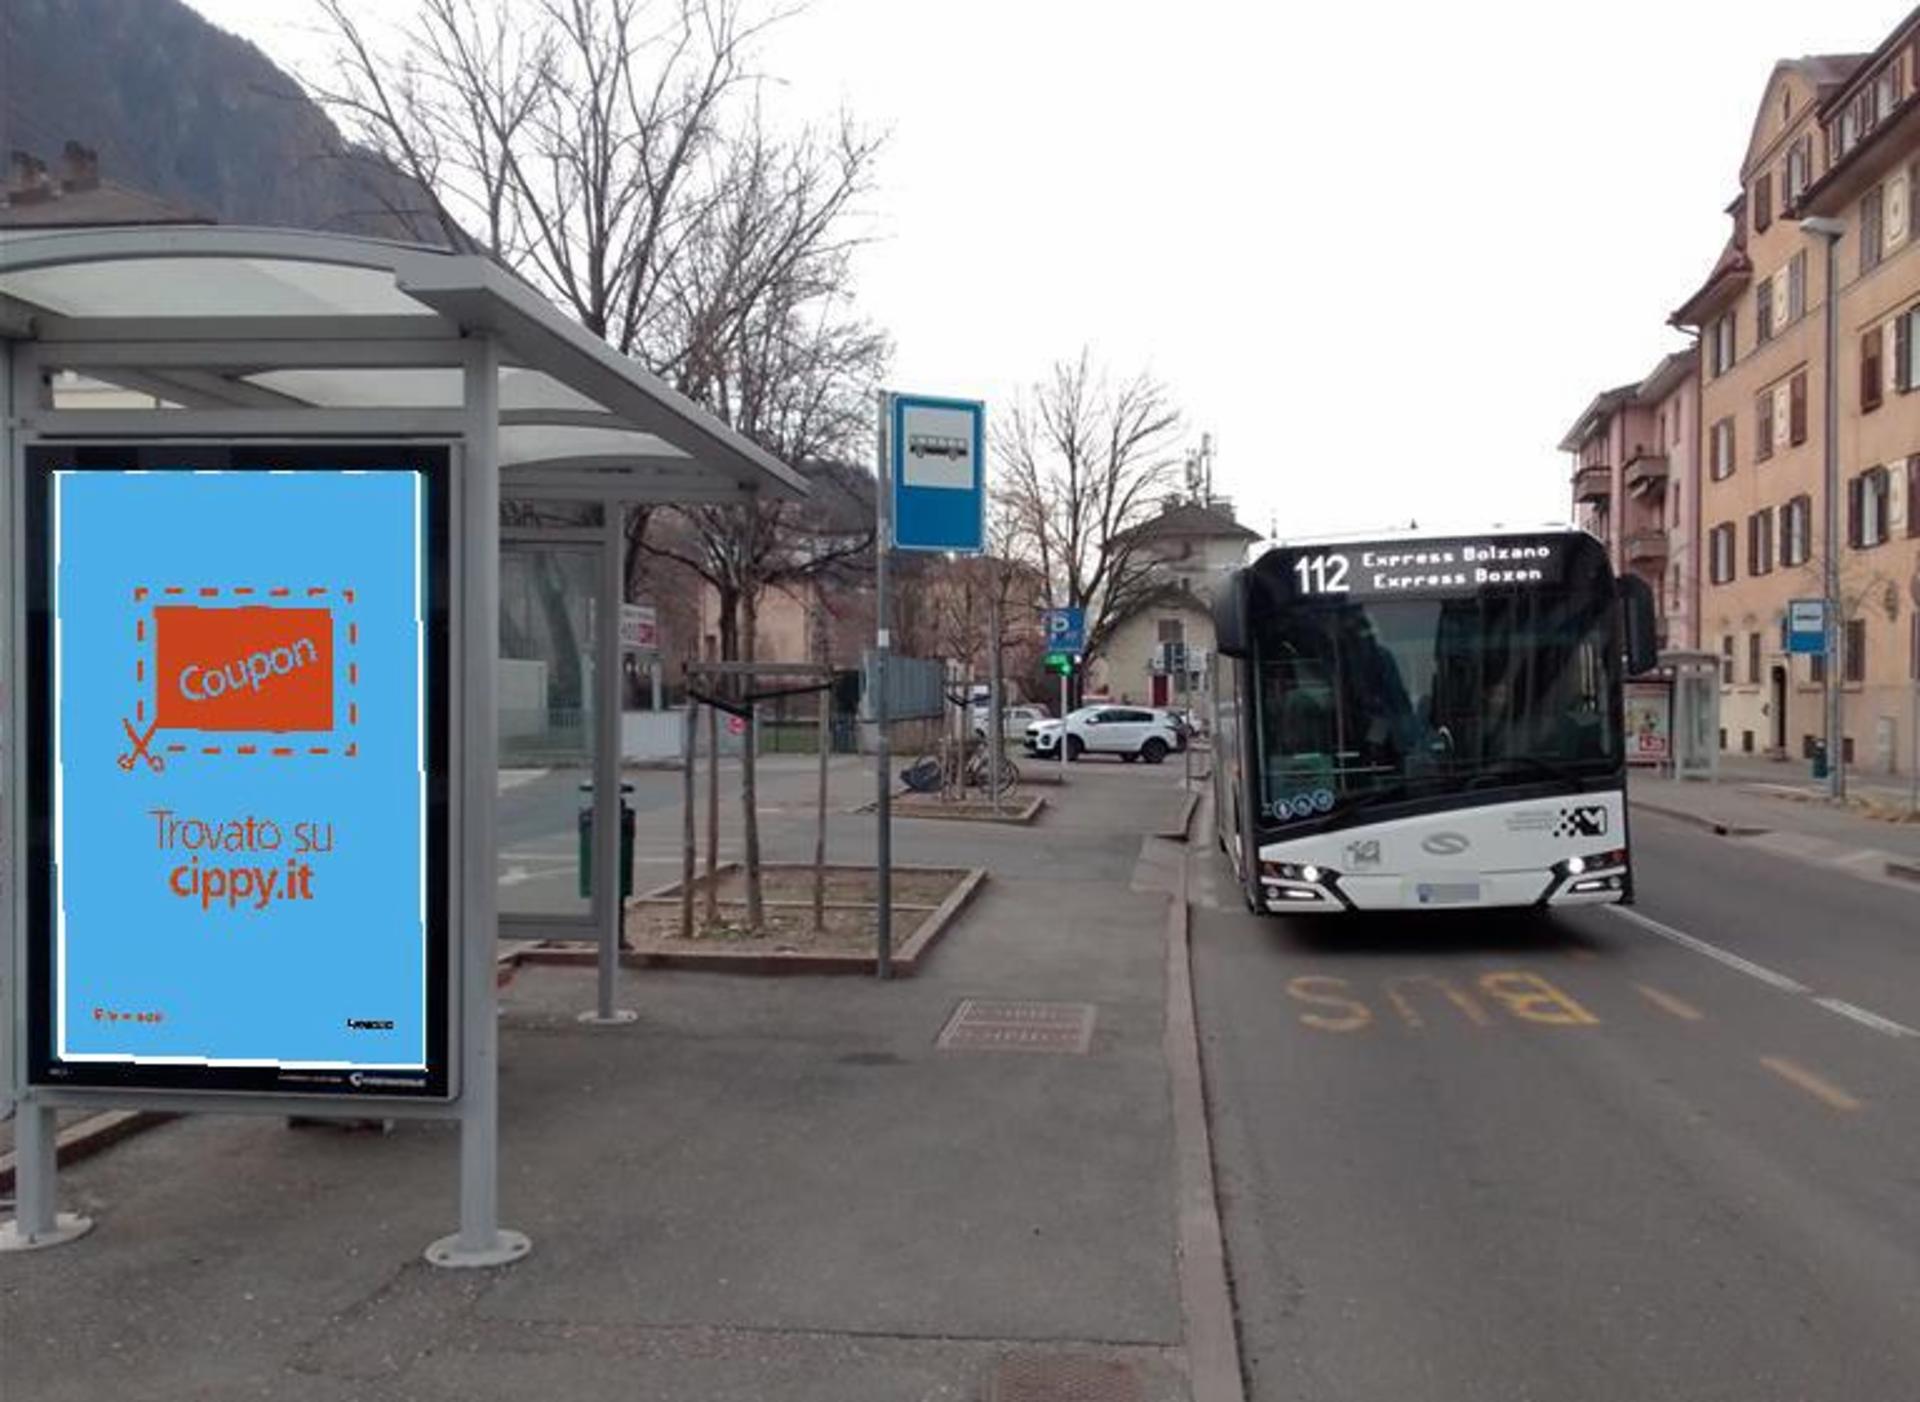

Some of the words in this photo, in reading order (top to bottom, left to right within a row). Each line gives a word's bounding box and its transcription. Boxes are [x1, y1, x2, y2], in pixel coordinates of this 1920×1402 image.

[1294, 554, 1350, 594] 112
[1362, 552, 1454, 568] Express
[1462, 545, 1551, 562] Bolzano
[1373, 574, 1466, 589] Express
[178, 637, 318, 700] Coupon
[148, 810, 281, 852] Trovato
[294, 822, 333, 853] su
[169, 855, 314, 911] cippy.it
